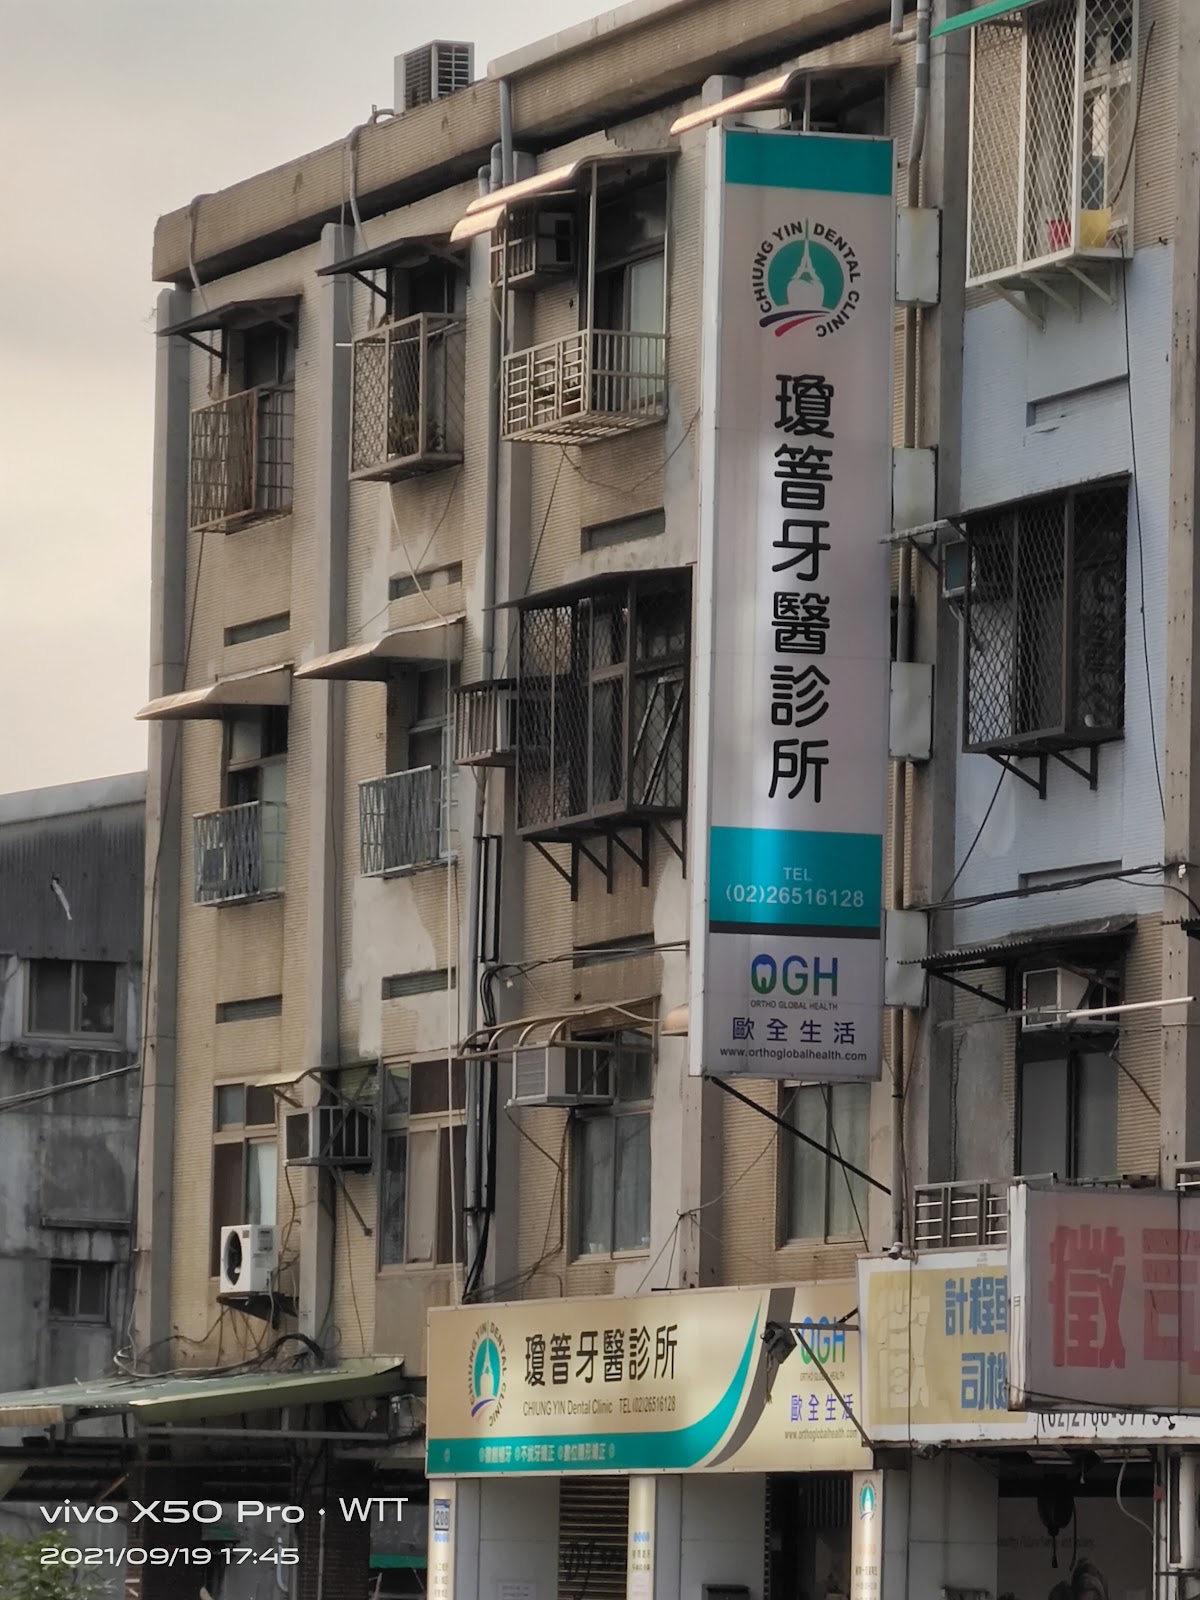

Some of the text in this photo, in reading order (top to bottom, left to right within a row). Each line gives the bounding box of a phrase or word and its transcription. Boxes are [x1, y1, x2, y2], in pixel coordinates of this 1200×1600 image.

[752, 221, 861, 338] CHIUNG YIN DENTAL CLINIC
[783, 867, 813, 881] TEL
[725, 884, 864, 908] (02)26516128
[751, 953, 838, 997] OGH
[750, 1000, 838, 1011] ORTHO GLOBAL HEALTH
[732, 1017, 856, 1045] 歐全生活
[720, 1047, 867, 1061] www.orthoglobalhealth.com
[490, 1322, 507, 1376] DENTAL
[489, 1382, 506, 1427] CLINIC
[523, 1401, 552, 1416] CHIUNG
[553, 1400, 566, 1415] YIN
[567, 1400, 590, 1415] Dental
[592, 1399, 613, 1414] Clinic
[619, 1398, 631, 1414] TEL
